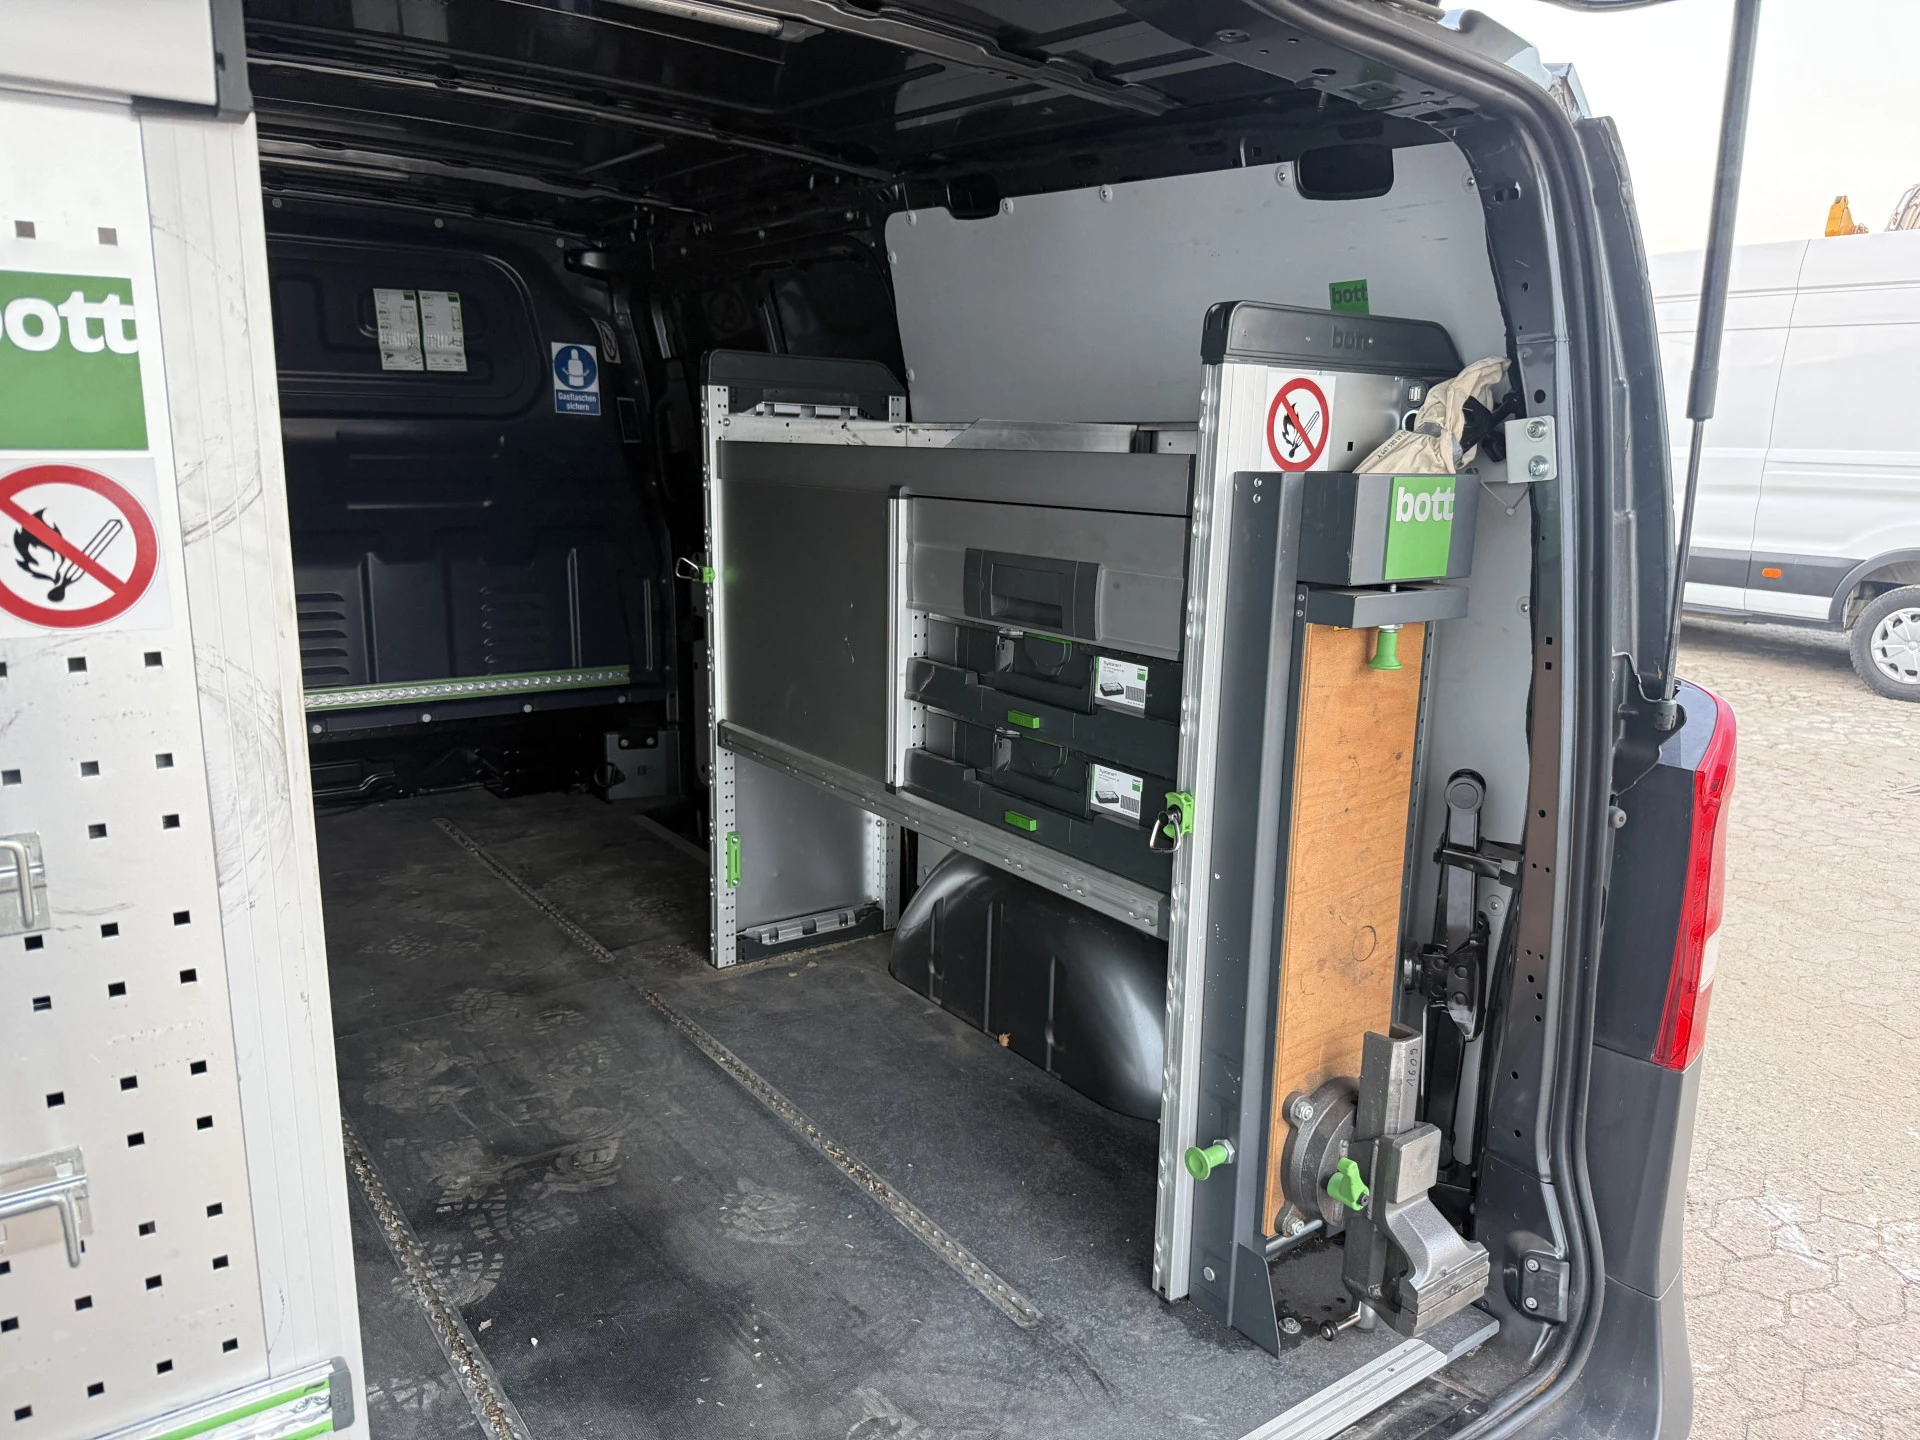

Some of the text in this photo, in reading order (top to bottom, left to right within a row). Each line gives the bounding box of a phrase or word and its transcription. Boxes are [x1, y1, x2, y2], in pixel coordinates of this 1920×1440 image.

[1331, 284, 1369, 305] bott
[0, 290, 139, 355] ott
[558, 391, 597, 403] Gasflaschen
[566, 402, 590, 411] sichern
[1395, 486, 1456, 523] bott
[1406, 1048, 1419, 1087] 1609
